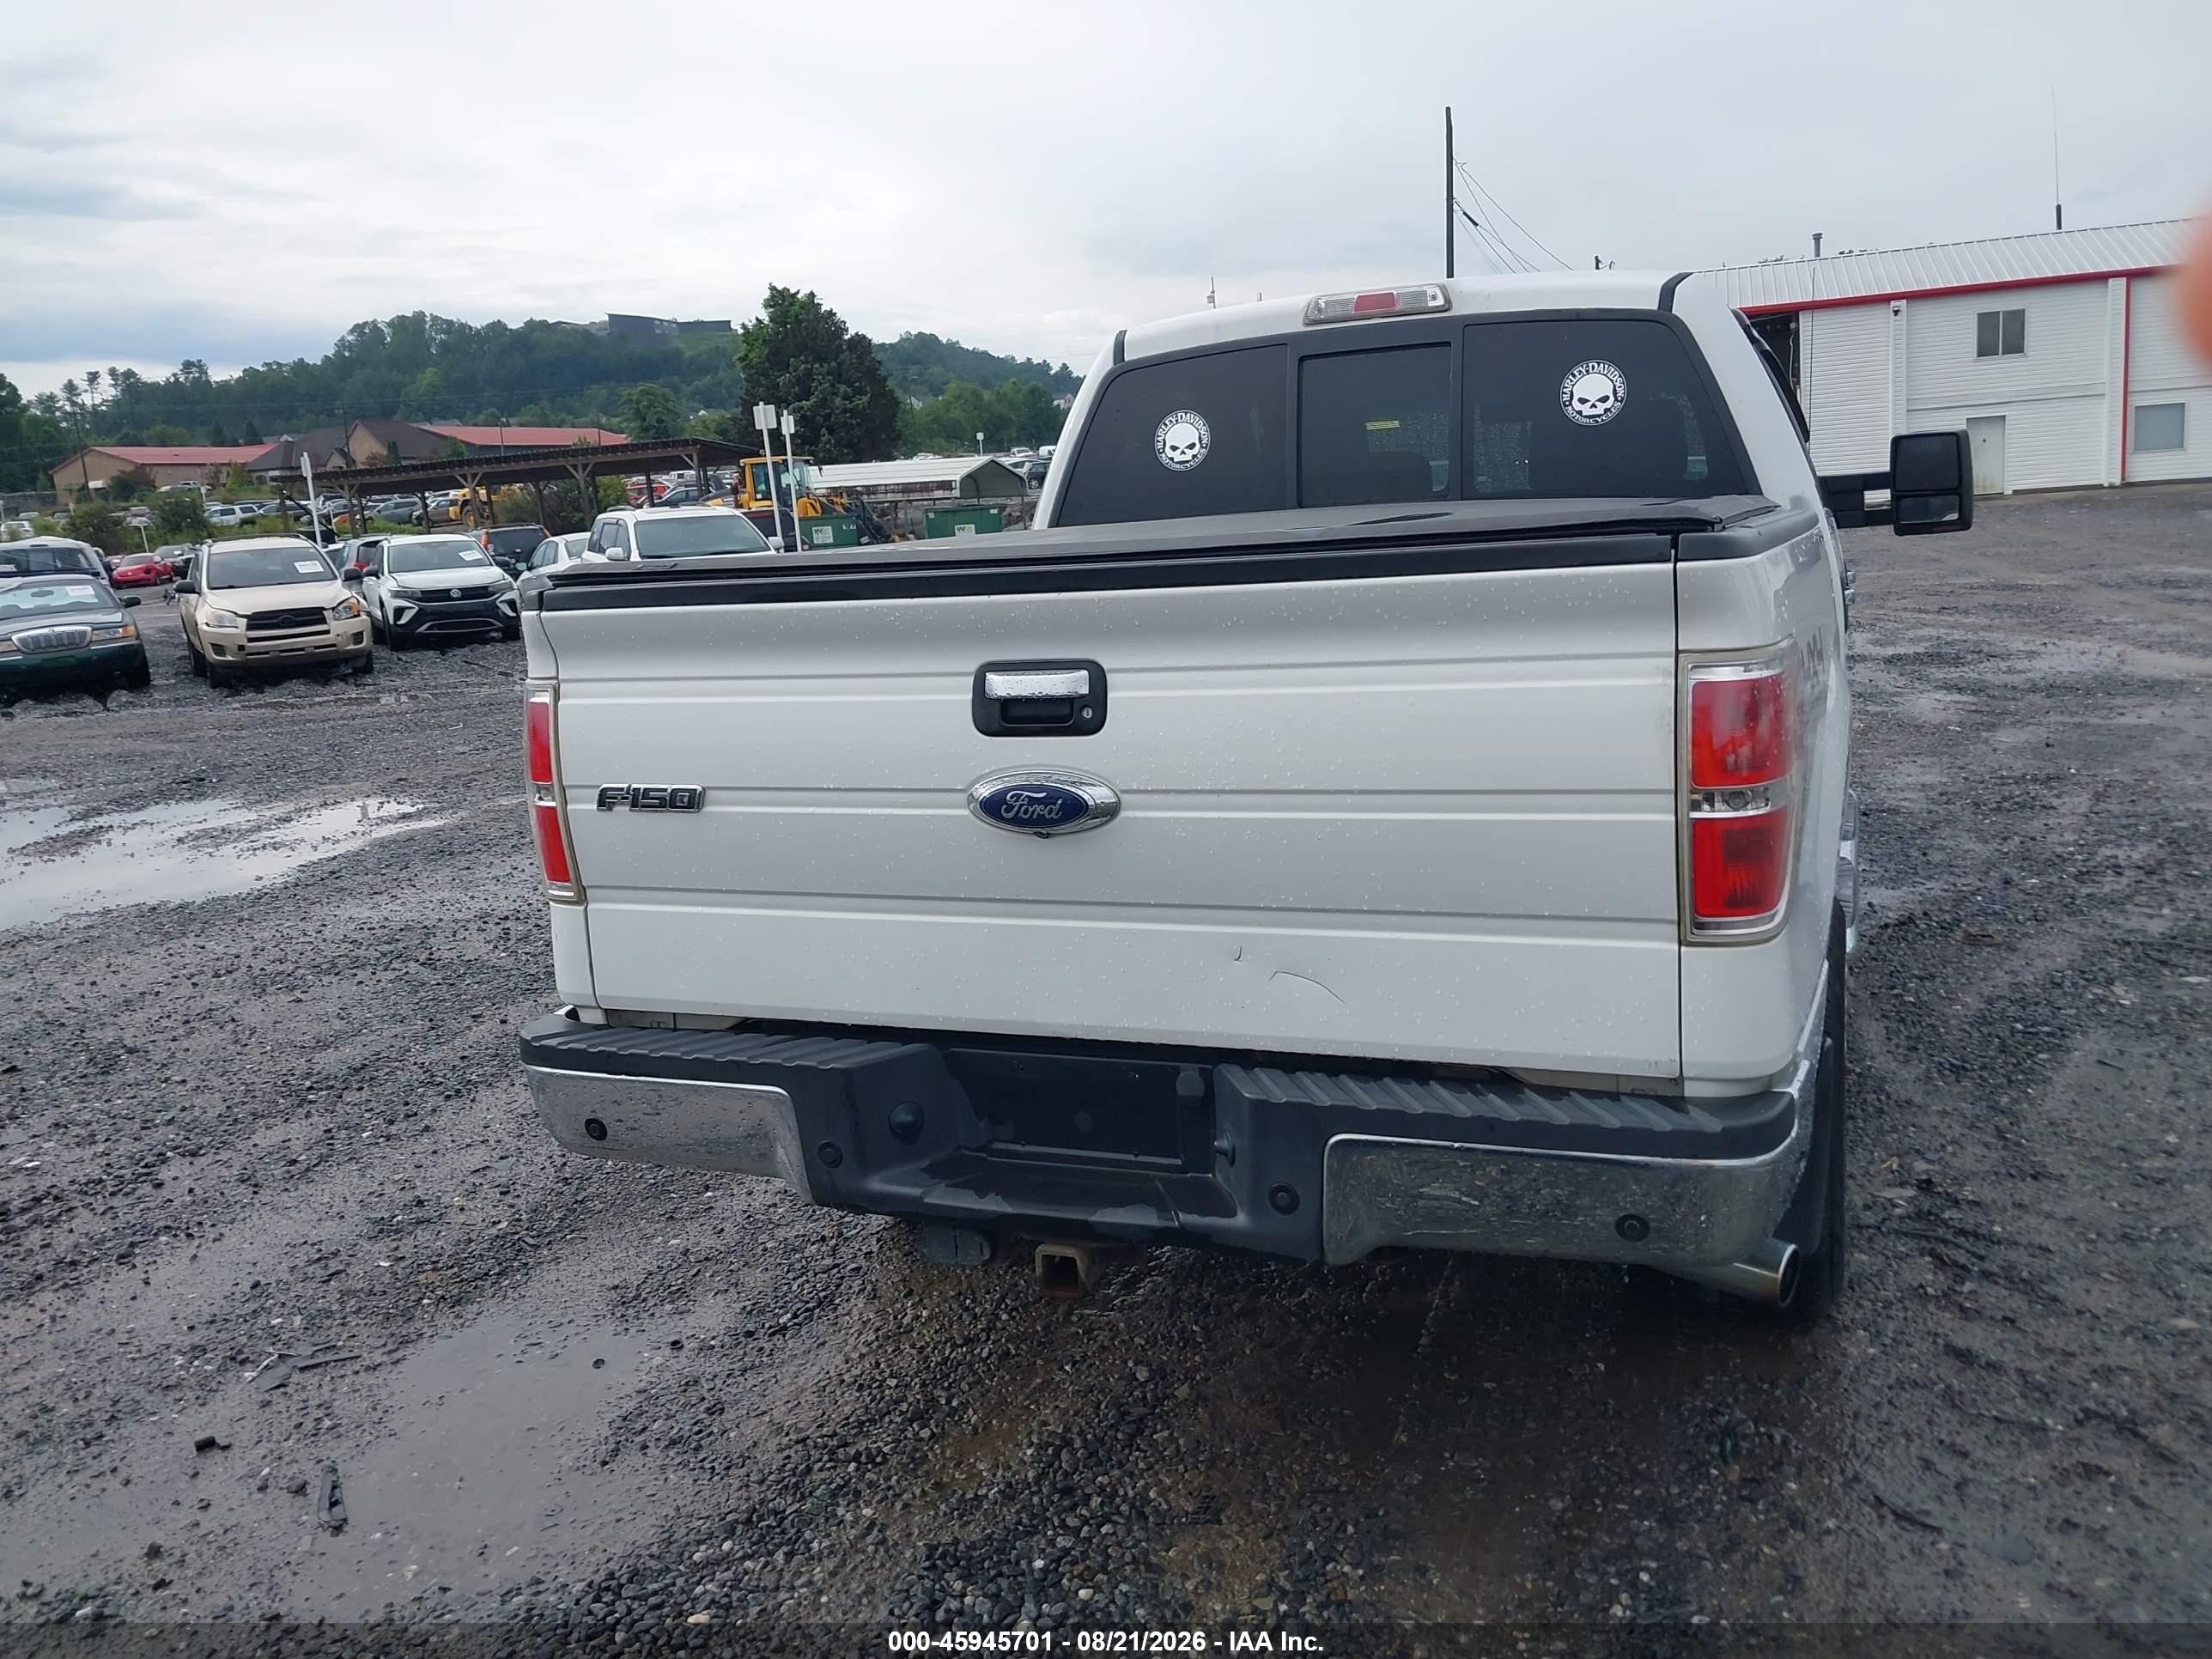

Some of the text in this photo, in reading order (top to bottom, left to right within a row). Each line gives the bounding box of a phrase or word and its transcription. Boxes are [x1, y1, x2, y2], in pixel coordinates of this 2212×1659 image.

[1565, 401, 1621, 423] MOTORCYCLES
[1159, 447, 1206, 469] MOTORCYCLES
[597, 783, 707, 813] F-150
[1001, 790, 1064, 819] Ford
